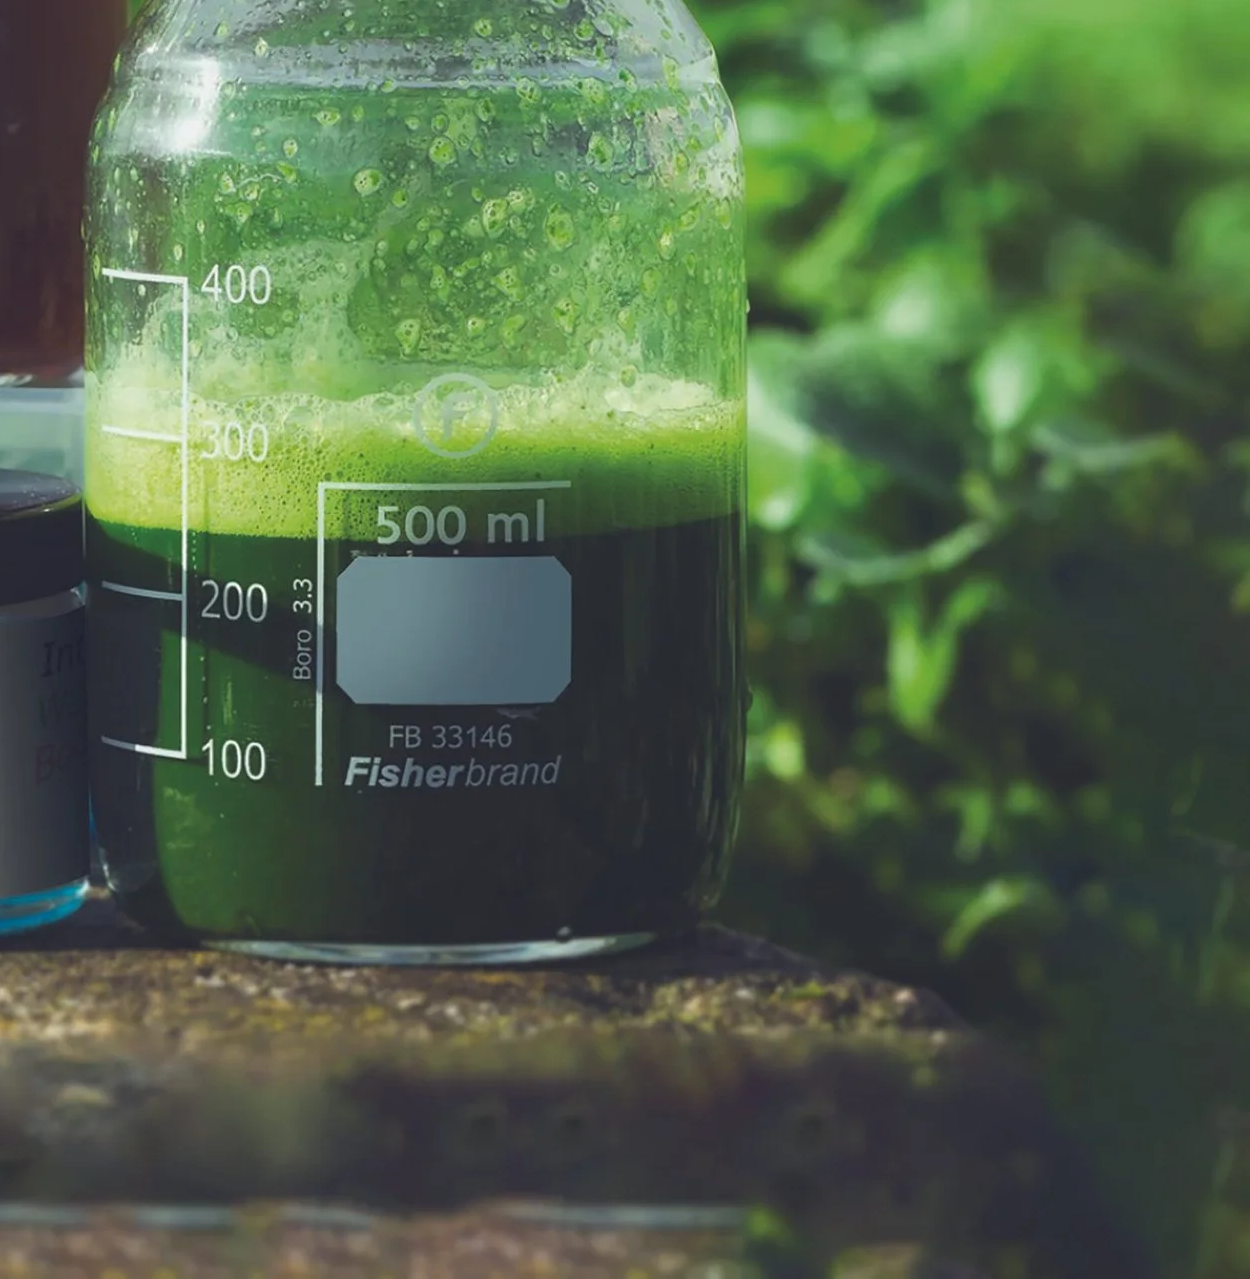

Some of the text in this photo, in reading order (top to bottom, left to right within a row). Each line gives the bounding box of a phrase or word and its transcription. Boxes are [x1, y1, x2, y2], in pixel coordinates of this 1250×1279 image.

[200, 265, 272, 305] 400
[200, 420, 268, 462] 300
[376, 498, 545, 545] 500 ml
[202, 580, 268, 622] 200
[293, 579, 313, 680] Boro 3.3
[389, 724, 513, 749] FB 33146
[201, 739, 266, 780] 100
[344, 755, 562, 788] Fisherbrand
